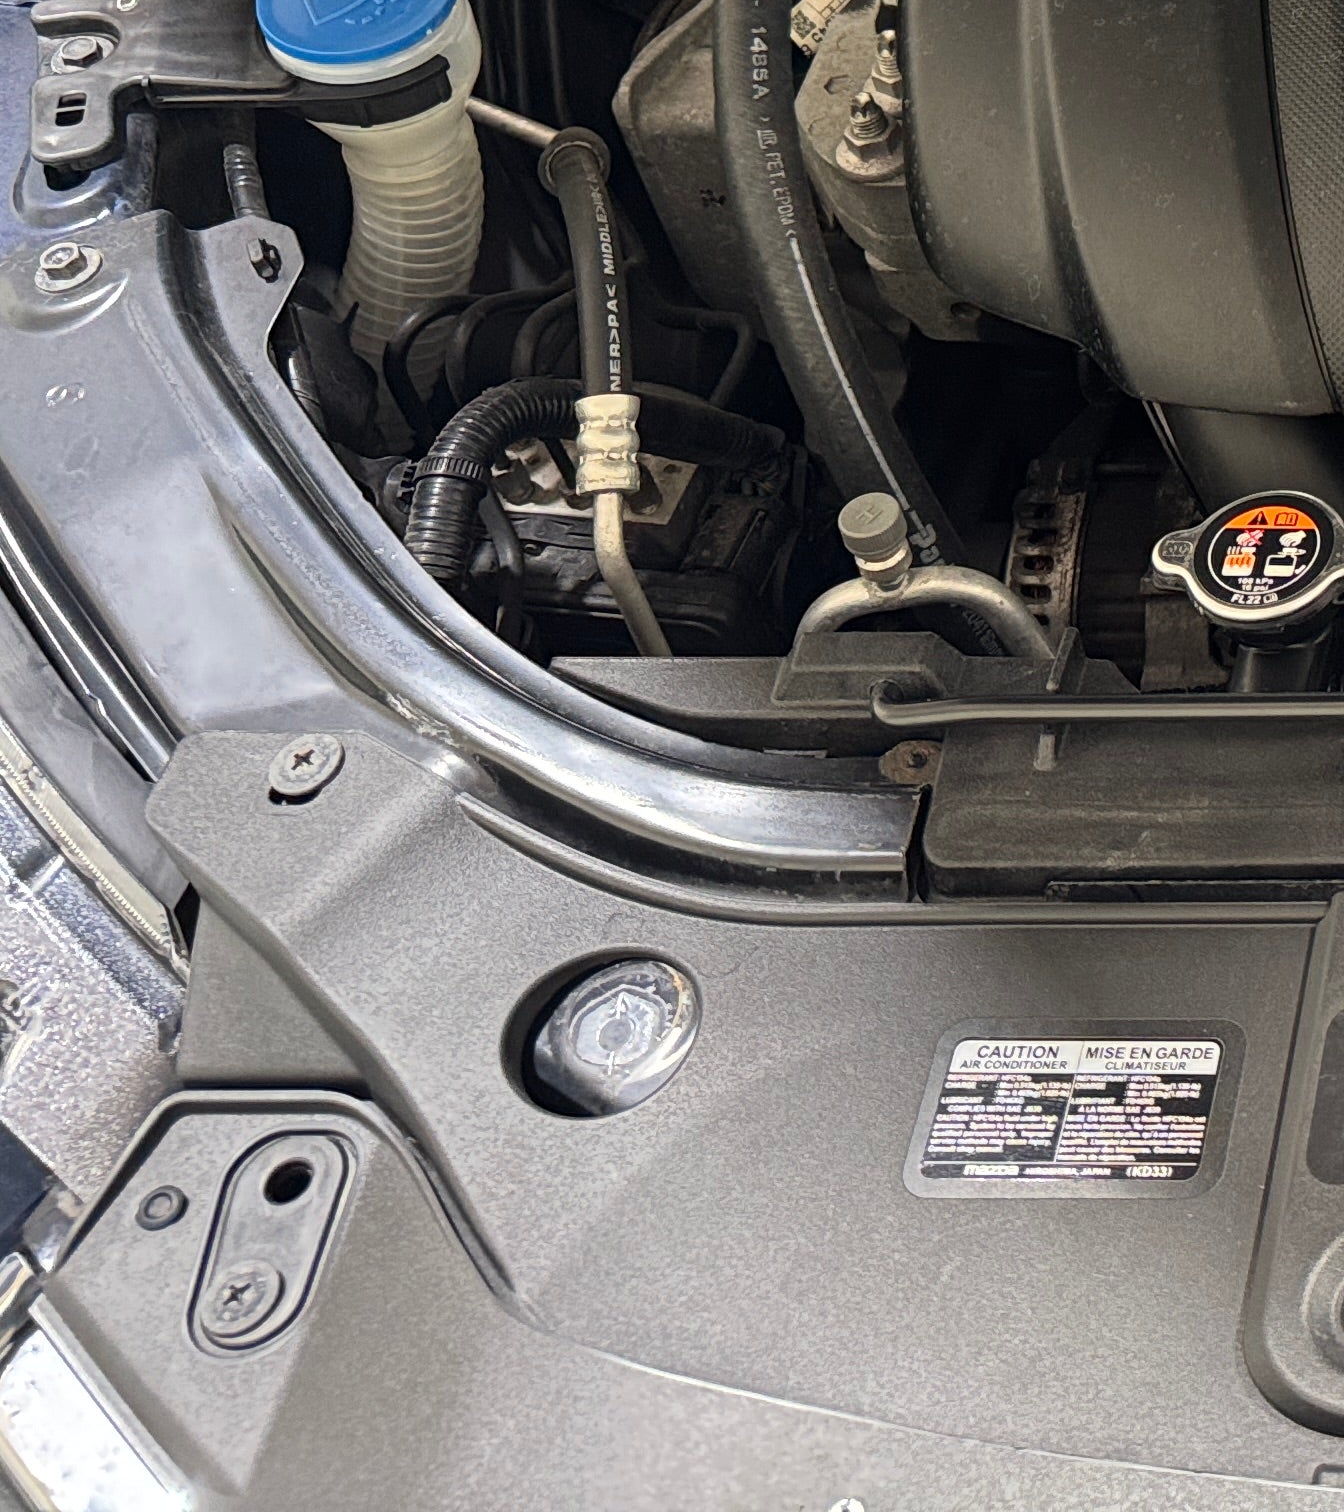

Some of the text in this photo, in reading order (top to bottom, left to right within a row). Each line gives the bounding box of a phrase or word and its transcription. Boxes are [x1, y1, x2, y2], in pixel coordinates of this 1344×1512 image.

[1255, 577, 1274, 585] kPa
[1230, 592, 1262, 605] FL22
[977, 1045, 1060, 1059] CAUTION
[1085, 1047, 1214, 1061] MISE EN GARDE
[959, 1060, 1068, 1071] AIR CONDITIONER
[1104, 1061, 1187, 1071] CLIMATISEUR
[962, 1164, 1020, 1176] mazda
[1080, 1167, 1112, 1176] JAPAN
[1125, 1166, 1173, 1178] (KD33)
